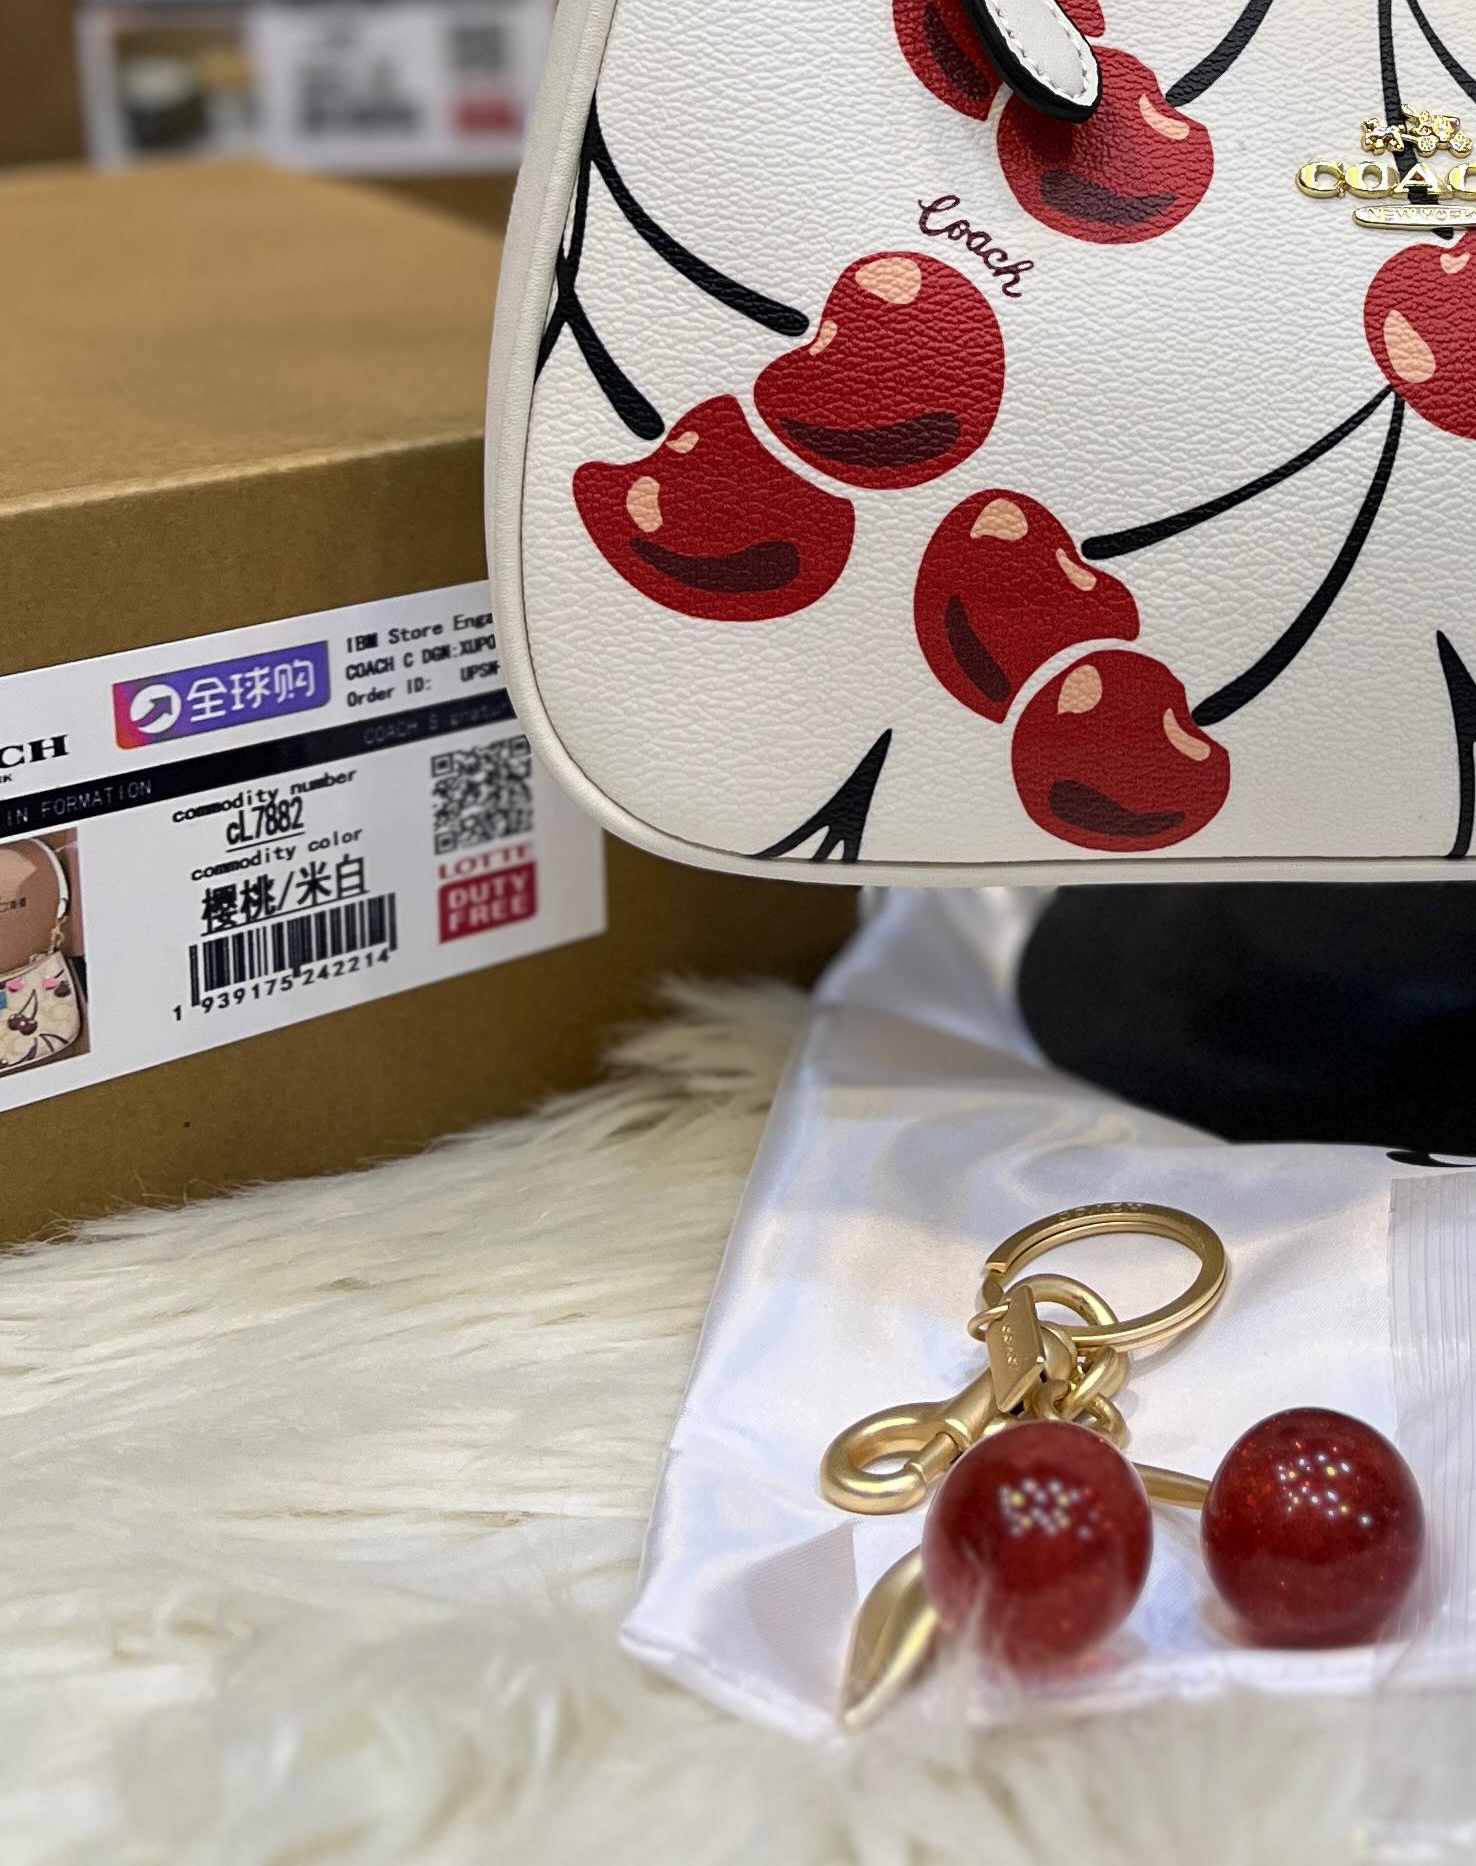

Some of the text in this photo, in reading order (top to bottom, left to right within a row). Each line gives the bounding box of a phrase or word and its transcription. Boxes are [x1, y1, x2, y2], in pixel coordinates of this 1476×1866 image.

[1367, 207, 1415, 222] NEW
[917, 194, 1035, 298] Coach
[388, 623, 443, 645] Store
[345, 655, 395, 681] COACH
[403, 651, 415, 668] C
[185, 658, 317, 723] 全球购
[347, 686, 395, 707] Order
[172, 769, 357, 824] commodity number
[225, 796, 305, 846] cL7882
[191, 828, 363, 882] commodity color
[439, 840, 534, 880] LOTTE
[448, 870, 530, 910] DUTY
[448, 894, 529, 933] FREE
[172, 1004, 182, 1022] 1
